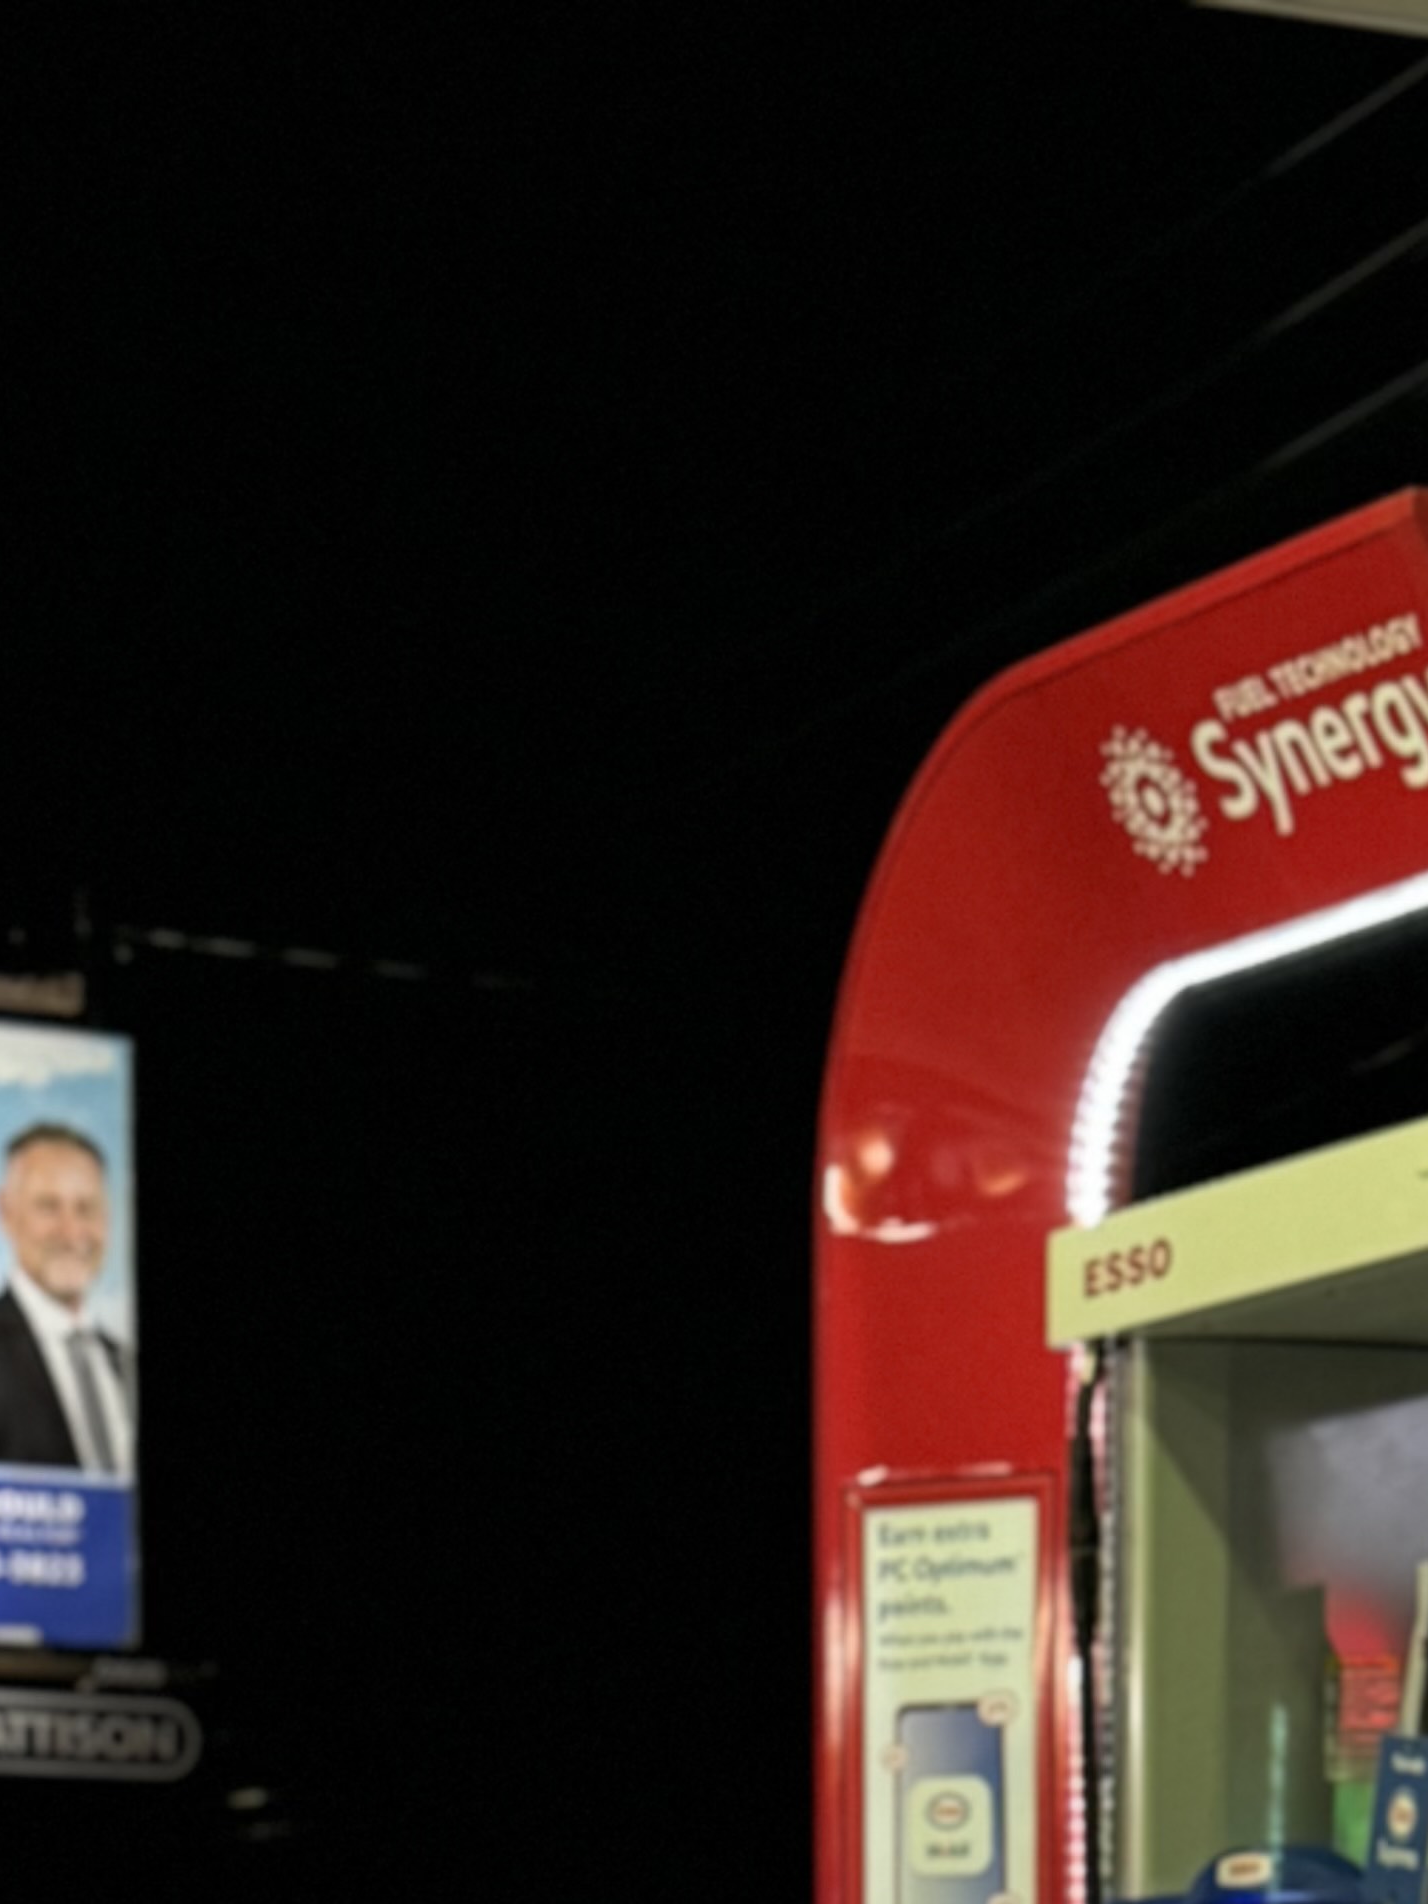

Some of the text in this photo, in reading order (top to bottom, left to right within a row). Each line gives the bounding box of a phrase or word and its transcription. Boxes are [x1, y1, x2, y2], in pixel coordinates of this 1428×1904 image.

[1213, 612, 1422, 721] FUEL TECHNOLOGY
[1083, 1236, 1174, 1299] ESSO
[879, 1521, 926, 1546] Earn
